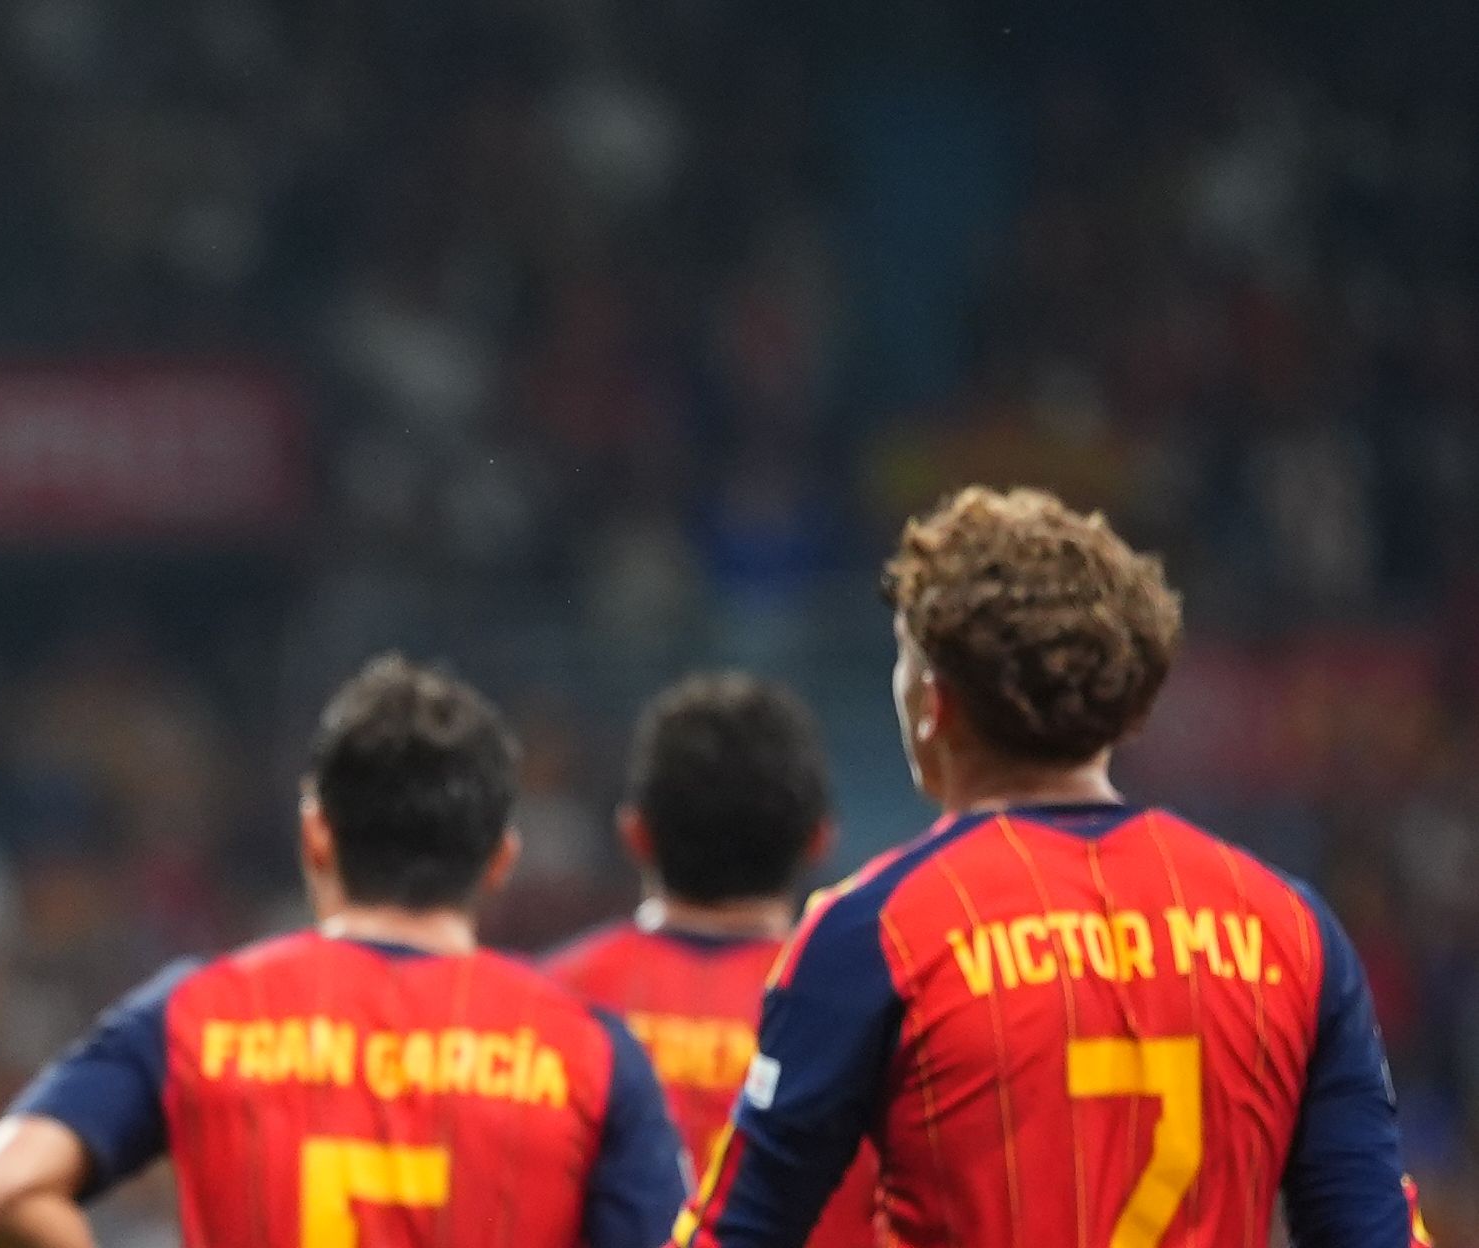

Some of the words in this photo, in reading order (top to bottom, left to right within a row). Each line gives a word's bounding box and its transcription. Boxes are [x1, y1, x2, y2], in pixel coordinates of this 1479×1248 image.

[945, 909, 1157, 998] VICTOR
[1162, 904, 1283, 987] M.V.
[201, 1015, 356, 1086] FRAN
[364, 1026, 568, 1108] GARCÍA
